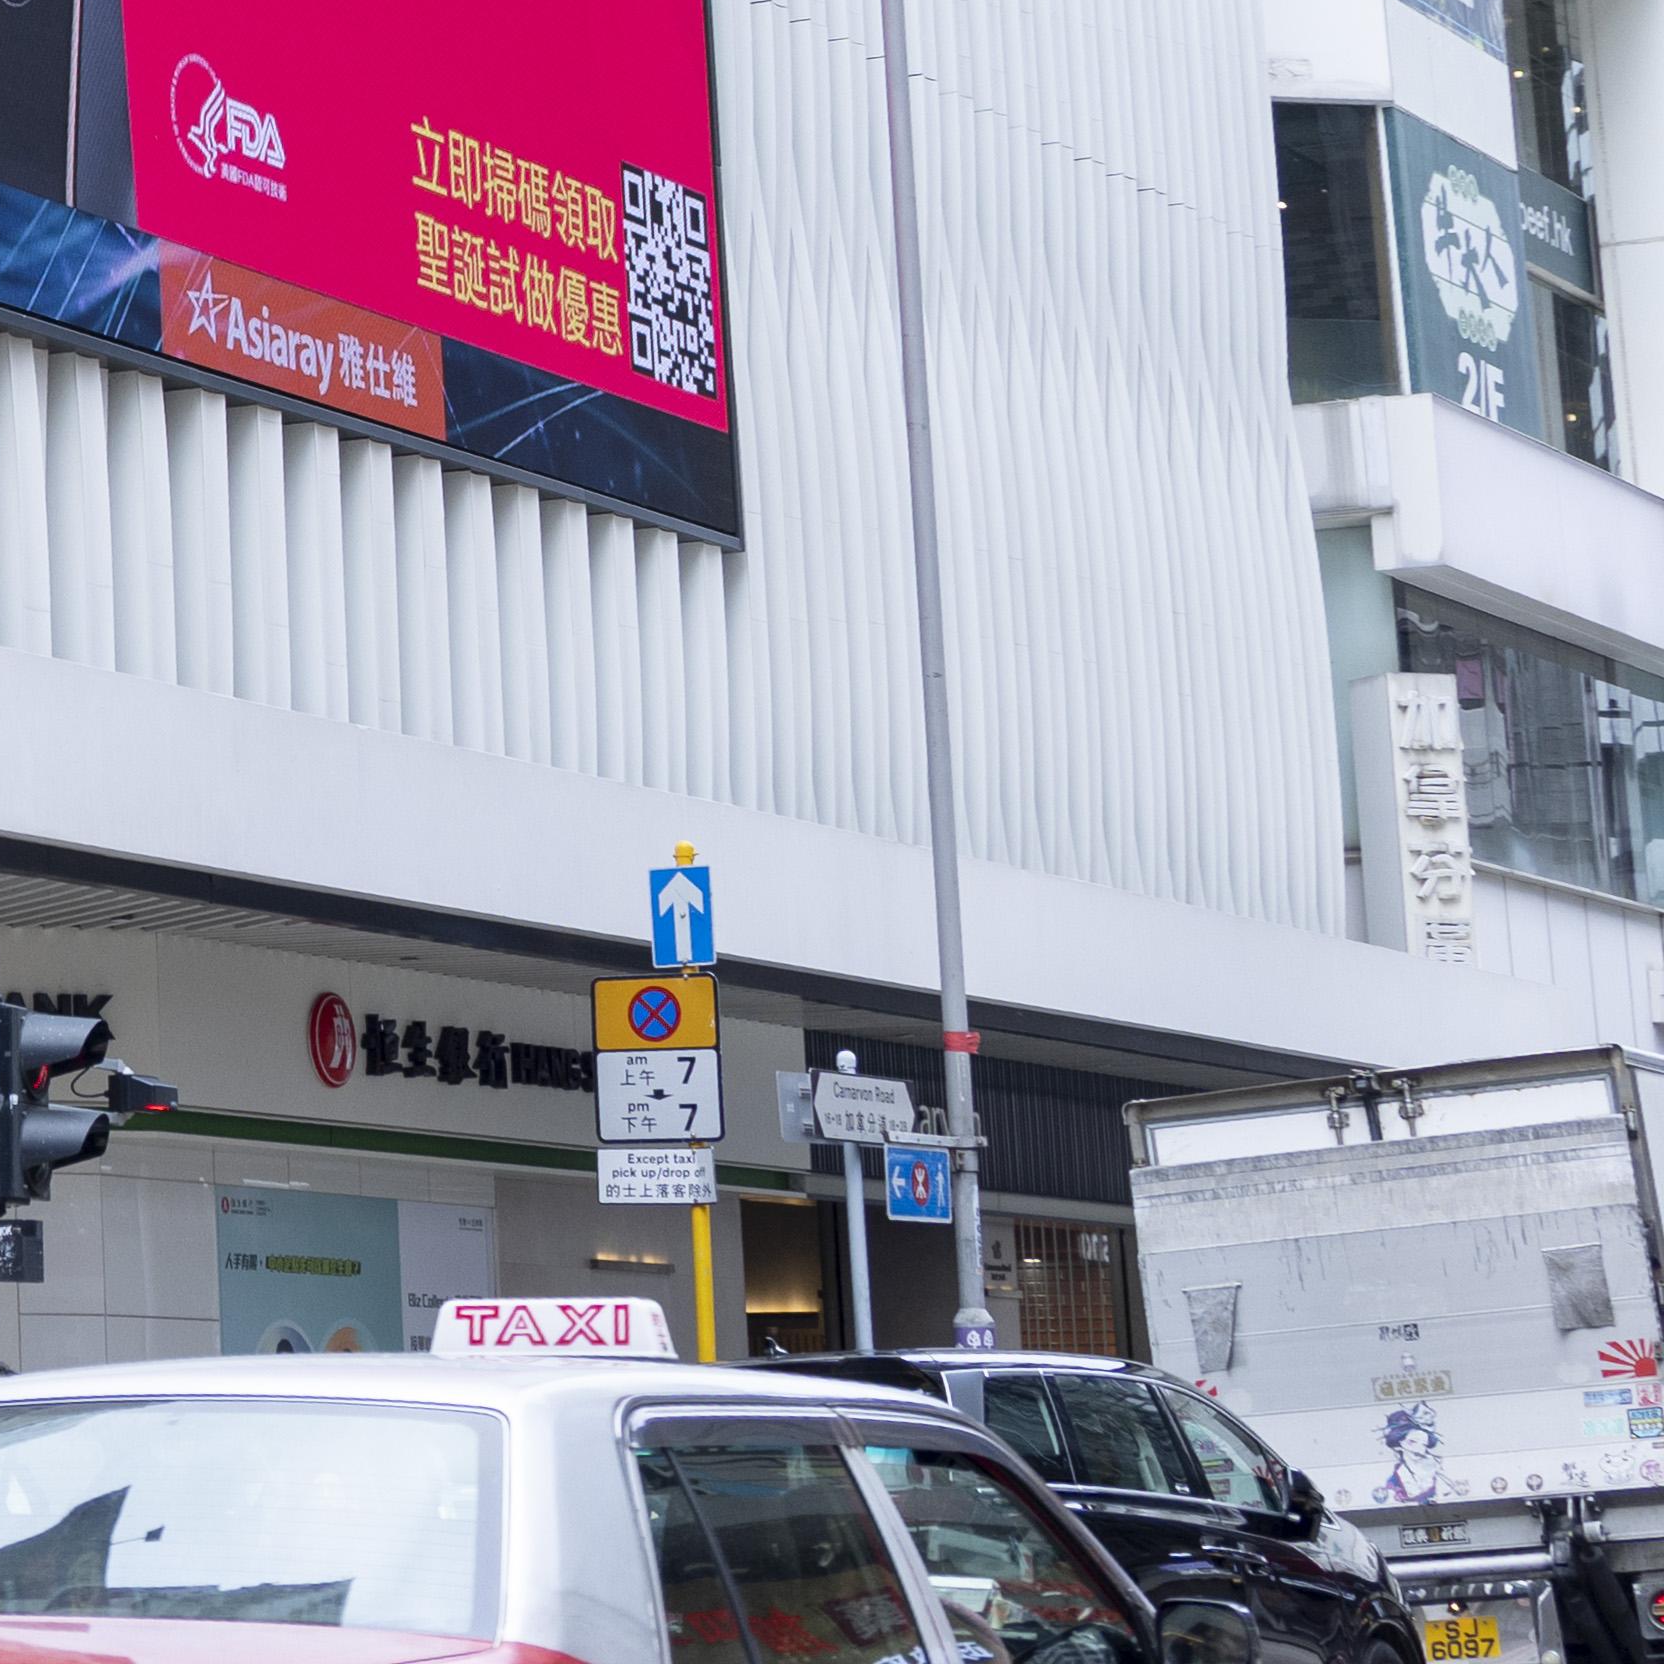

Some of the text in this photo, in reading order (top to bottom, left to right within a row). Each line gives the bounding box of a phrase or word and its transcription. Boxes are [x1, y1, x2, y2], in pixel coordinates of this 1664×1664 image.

[225, 96, 286, 170] FDA
[410, 115, 619, 264] 立即掃碼領取
[413, 210, 624, 358] 聖誕試做優惠
[226, 296, 419, 409] Asiaray 雅仕維
[620, 1069, 655, 1086] 上午
[626, 1056, 696, 1084] am 7
[875, 1087, 895, 1105] Road
[621, 1116, 657, 1133] 下午
[628, 1102, 698, 1131] pm 7
[628, 1154, 696, 1165] Except taxi
[612, 1167, 706, 1180] pick up/drop off
[606, 1183, 712, 1198] 的士上落客除外
[455, 1305, 630, 1346] TAXI
[1445, 1619, 1479, 1638] SJ
[1431, 1638, 1495, 1661] 6097
